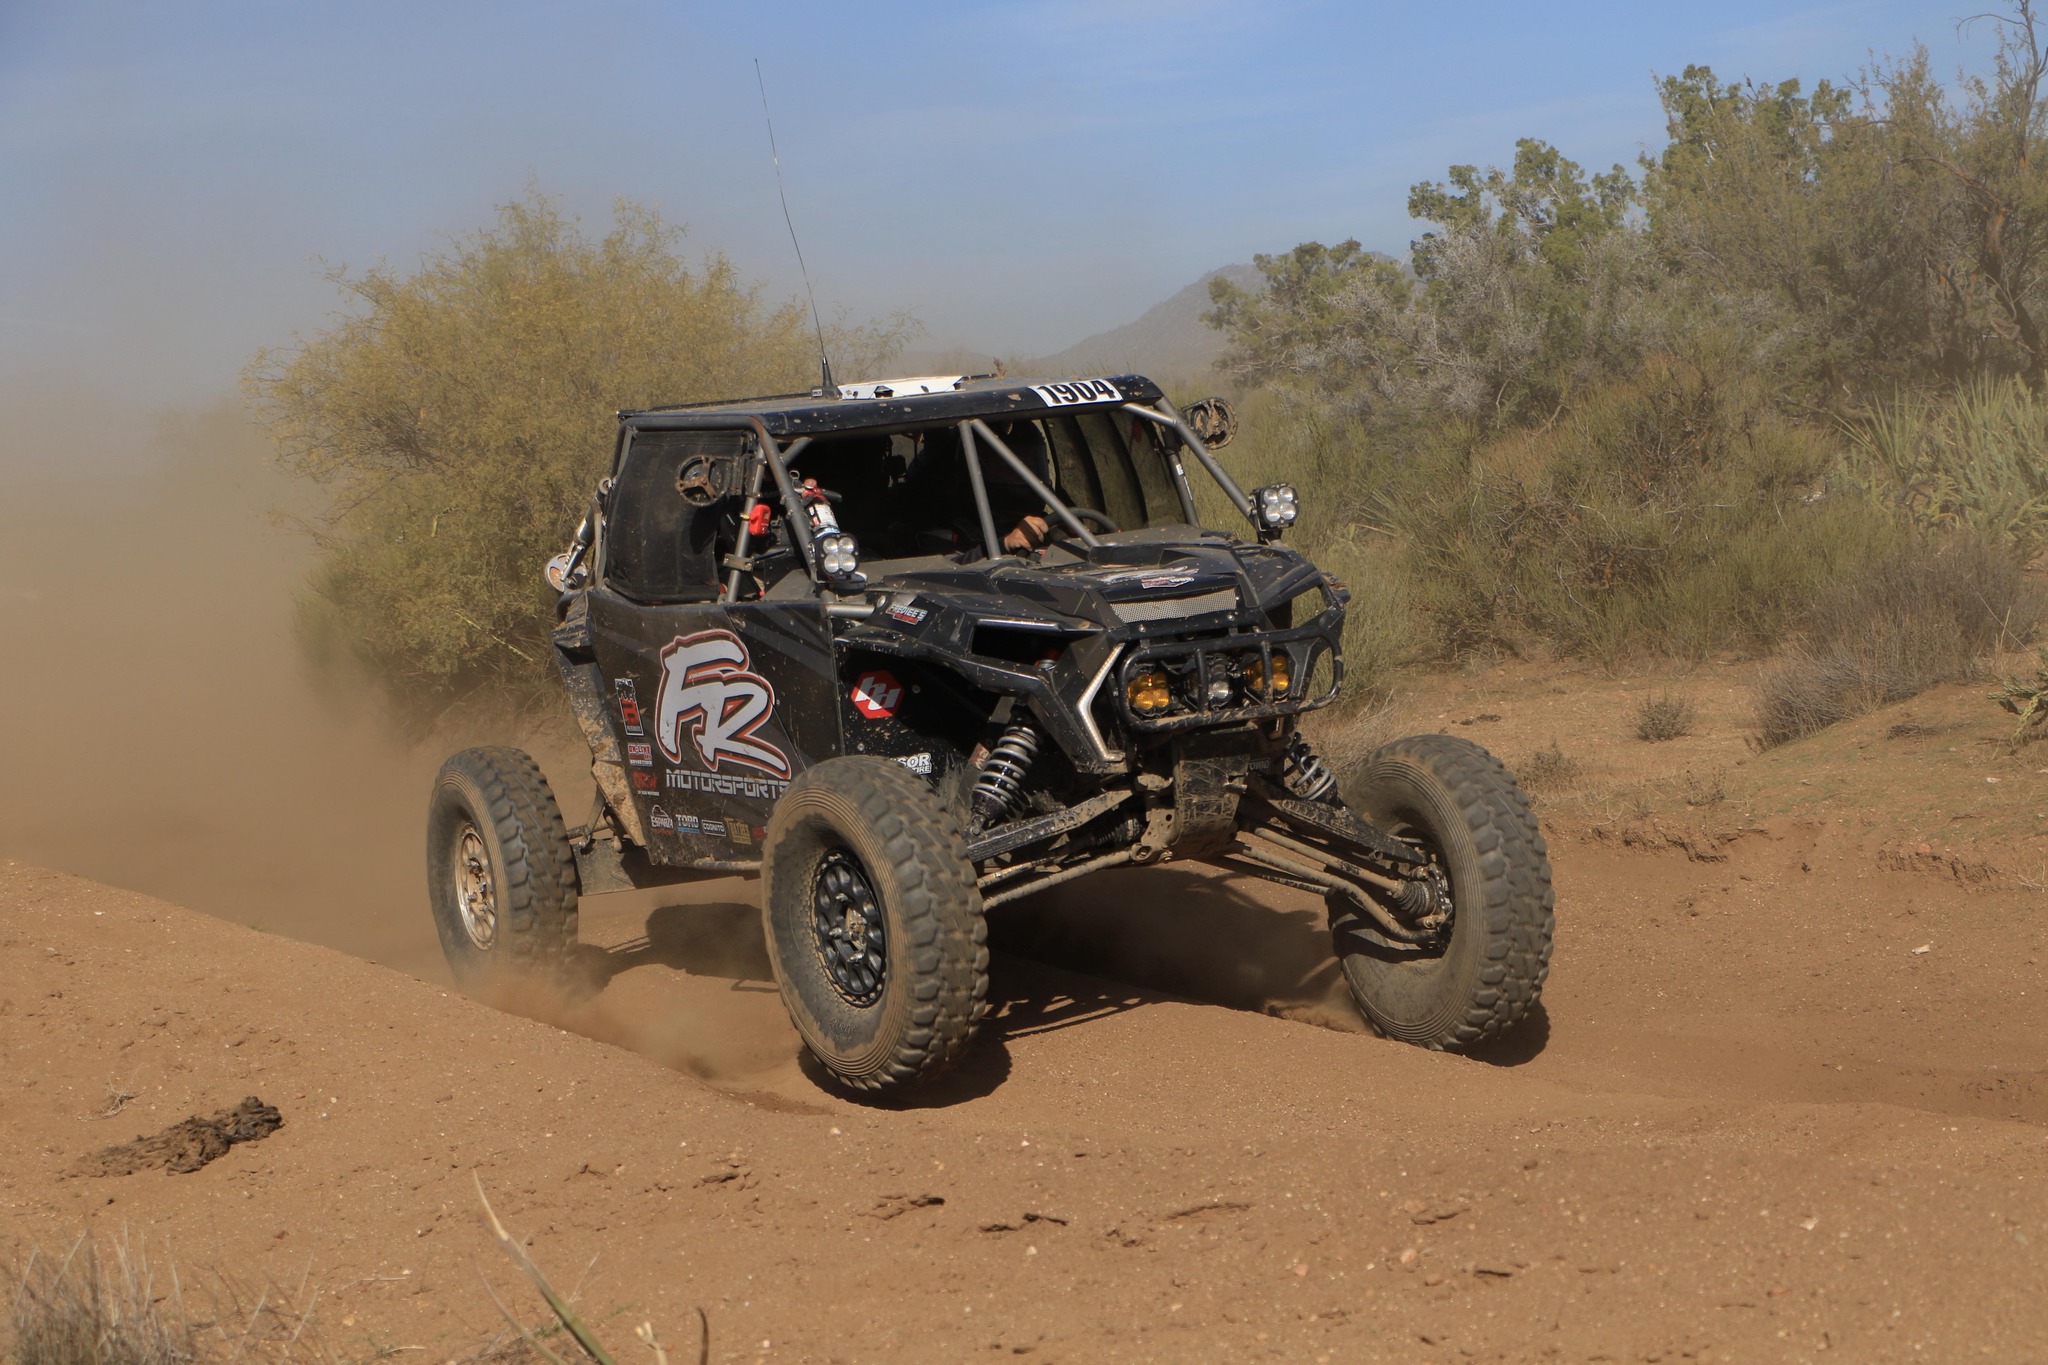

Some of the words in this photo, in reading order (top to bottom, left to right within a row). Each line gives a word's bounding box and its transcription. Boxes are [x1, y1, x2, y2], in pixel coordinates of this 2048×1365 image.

[1037, 380, 1115, 404] 1904
[656, 630, 791, 778] FR
[892, 753, 930, 768] SOR
[675, 814, 699, 828] TORO
[702, 822, 725, 832] COGNITO
